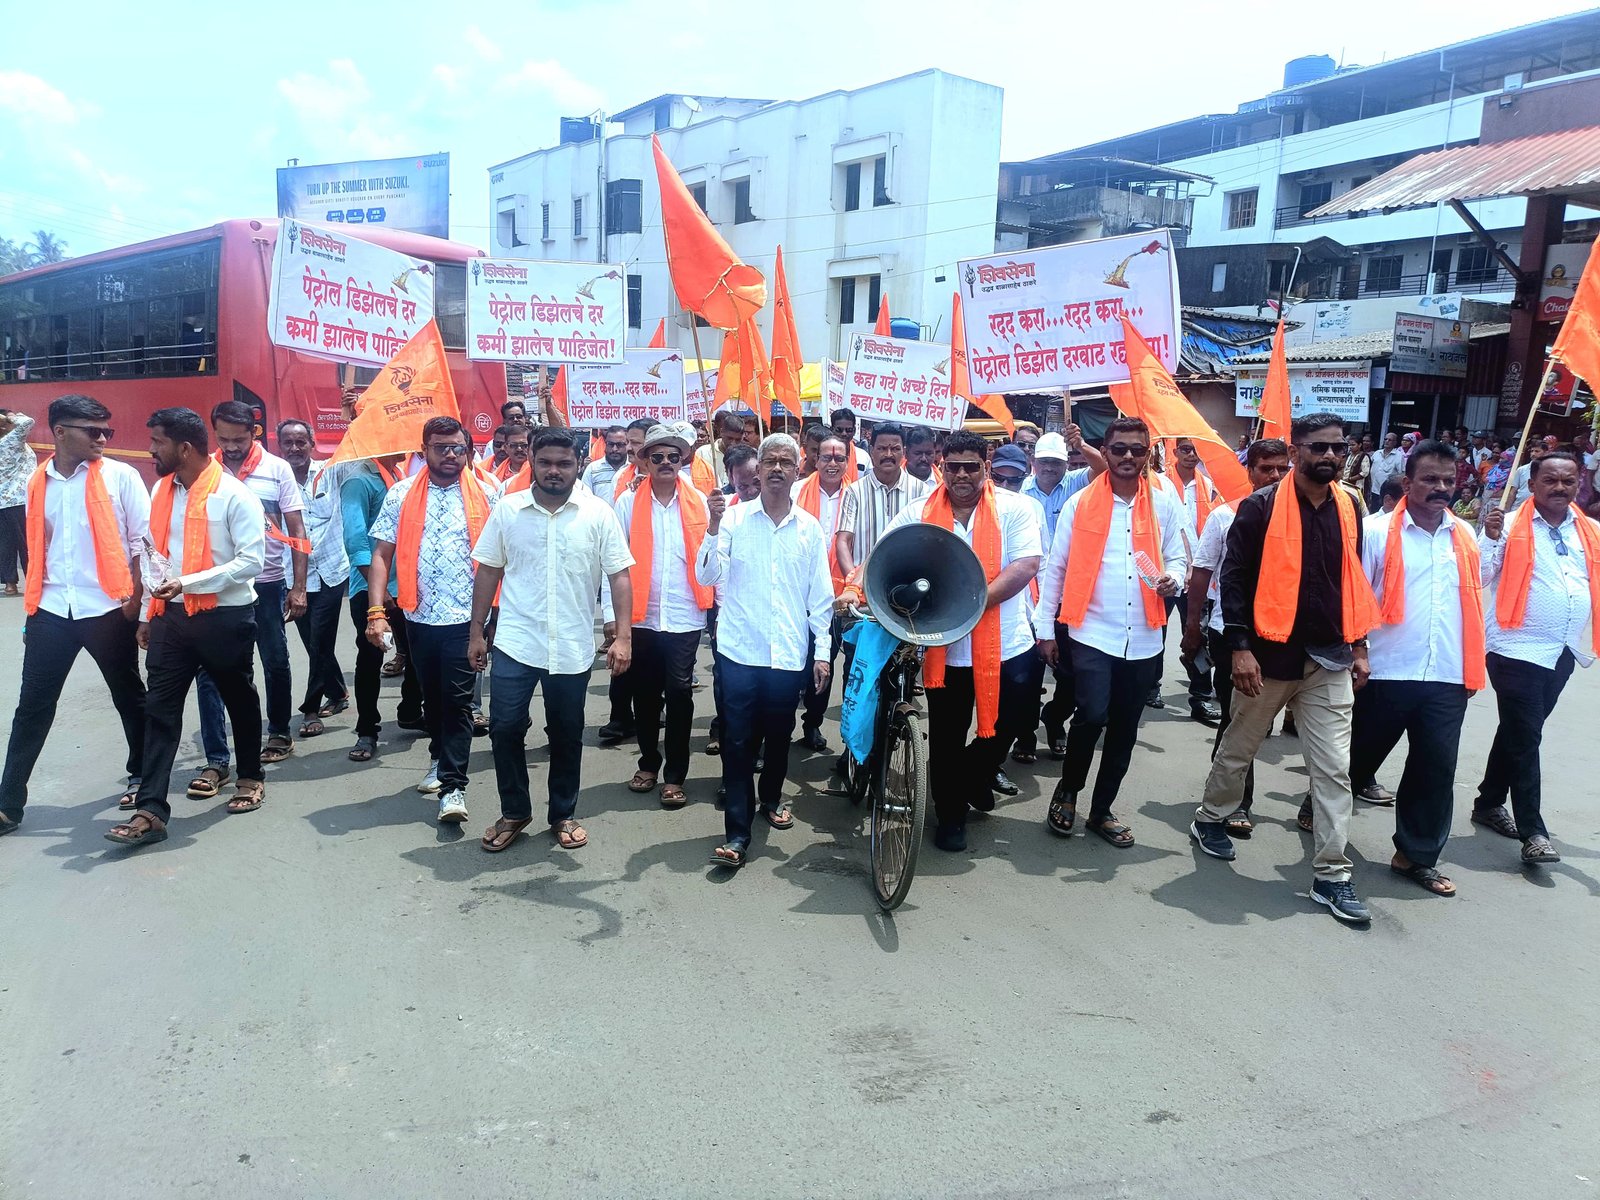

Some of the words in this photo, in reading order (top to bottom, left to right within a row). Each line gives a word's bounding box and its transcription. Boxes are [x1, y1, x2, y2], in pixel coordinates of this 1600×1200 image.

[423, 159, 447, 168] SUZUKI
[306, 184, 320, 196] TURN
[322, 182, 330, 194] UP
[331, 181, 341, 194] THE
[342, 180, 367, 192] SUMMER
[368, 178, 384, 191] WITH
[385, 176, 410, 190] SUZUKI.
[300, 227, 346, 256] शिवसेना
[482, 262, 528, 279] शिवसेना
[977, 260, 1036, 284] शिवसेना
[1022, 278, 1036, 288] ठाकरे
[302, 264, 342, 309] पेट्रोल
[346, 276, 398, 320] डिझेलचे
[402, 299, 417, 325] दर
[488, 292, 526, 325] पेट्रोल
[530, 294, 584, 325] डिझेलचे
[588, 305, 604, 326] दर
[286, 310, 319, 344] कमी
[322, 318, 368, 353] झालेच
[988, 311, 1014, 342] रद्द
[476, 327, 506, 354] कमी
[510, 328, 554, 359] झालेच
[558, 330, 616, 360] पाहिजेत!
[864, 339, 906, 358] शिवसेना
[972, 346, 1010, 384] पेट्रोल
[1014, 340, 1058, 377] डिझेल
[1062, 343, 1106, 372] दरवाढ
[582, 381, 598, 398] रद्द
[854, 371, 877, 390] कहा
[880, 371, 898, 392] गये
[901, 374, 927, 395] अच्छे
[930, 376, 950, 400] दिन
[1240, 386, 1264, 400] नाथ
[1312, 384, 1330, 394] श्रमिक
[1332, 386, 1356, 394] कामगार
[384, 396, 434, 415] शिवसेना
[850, 393, 874, 412] कहा
[876, 393, 894, 414] गये
[897, 397, 923, 418] अच्छे
[925, 398, 946, 422] दिन
[1316, 394, 1352, 404] कल्याणकारी
[1354, 394, 1366, 404] संघ
[572, 400, 594, 422] पेट्रोल
[596, 400, 620, 422] डिझेल
[623, 406, 646, 420] दरवाढ
[662, 406, 680, 420] करा!
